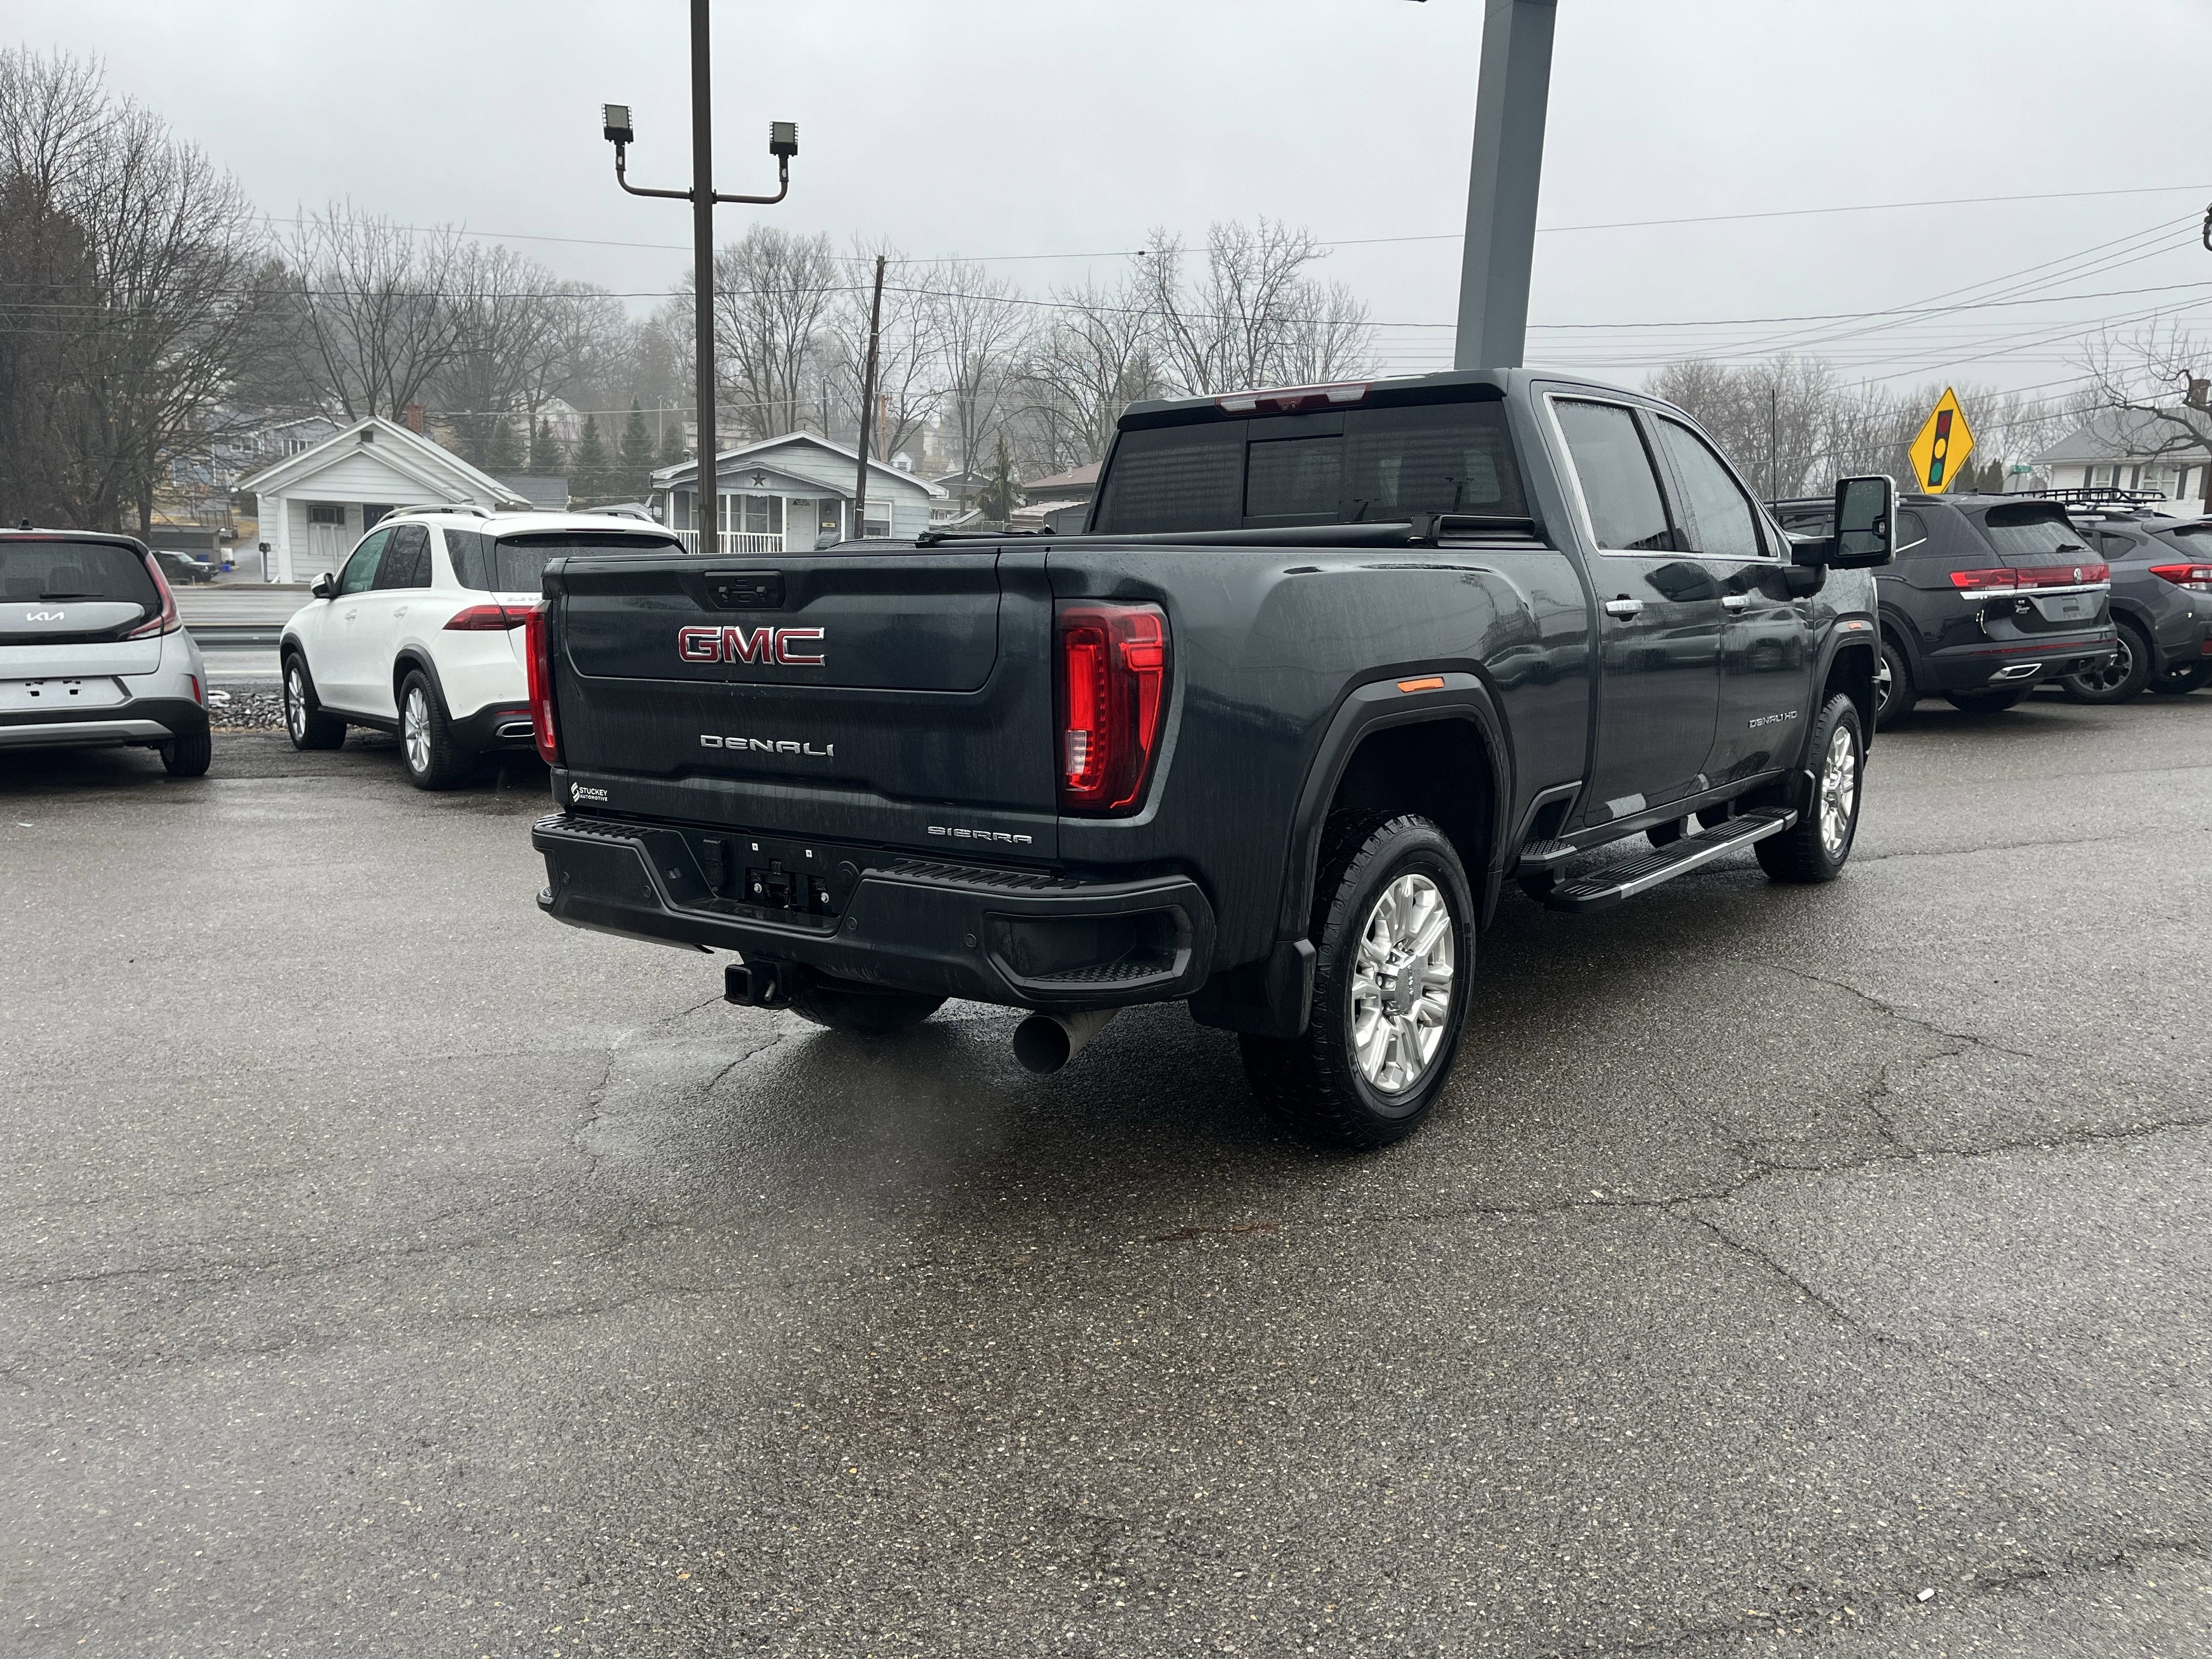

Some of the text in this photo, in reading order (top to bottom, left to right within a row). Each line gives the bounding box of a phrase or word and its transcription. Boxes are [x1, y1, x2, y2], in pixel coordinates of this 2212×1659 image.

[679, 626, 826, 667] GMC
[1748, 711, 1798, 729] DENALI HD
[700, 735, 834, 757] DENALI
[579, 787, 607, 796] STUCKEY
[928, 826, 1032, 844] SIERRA
